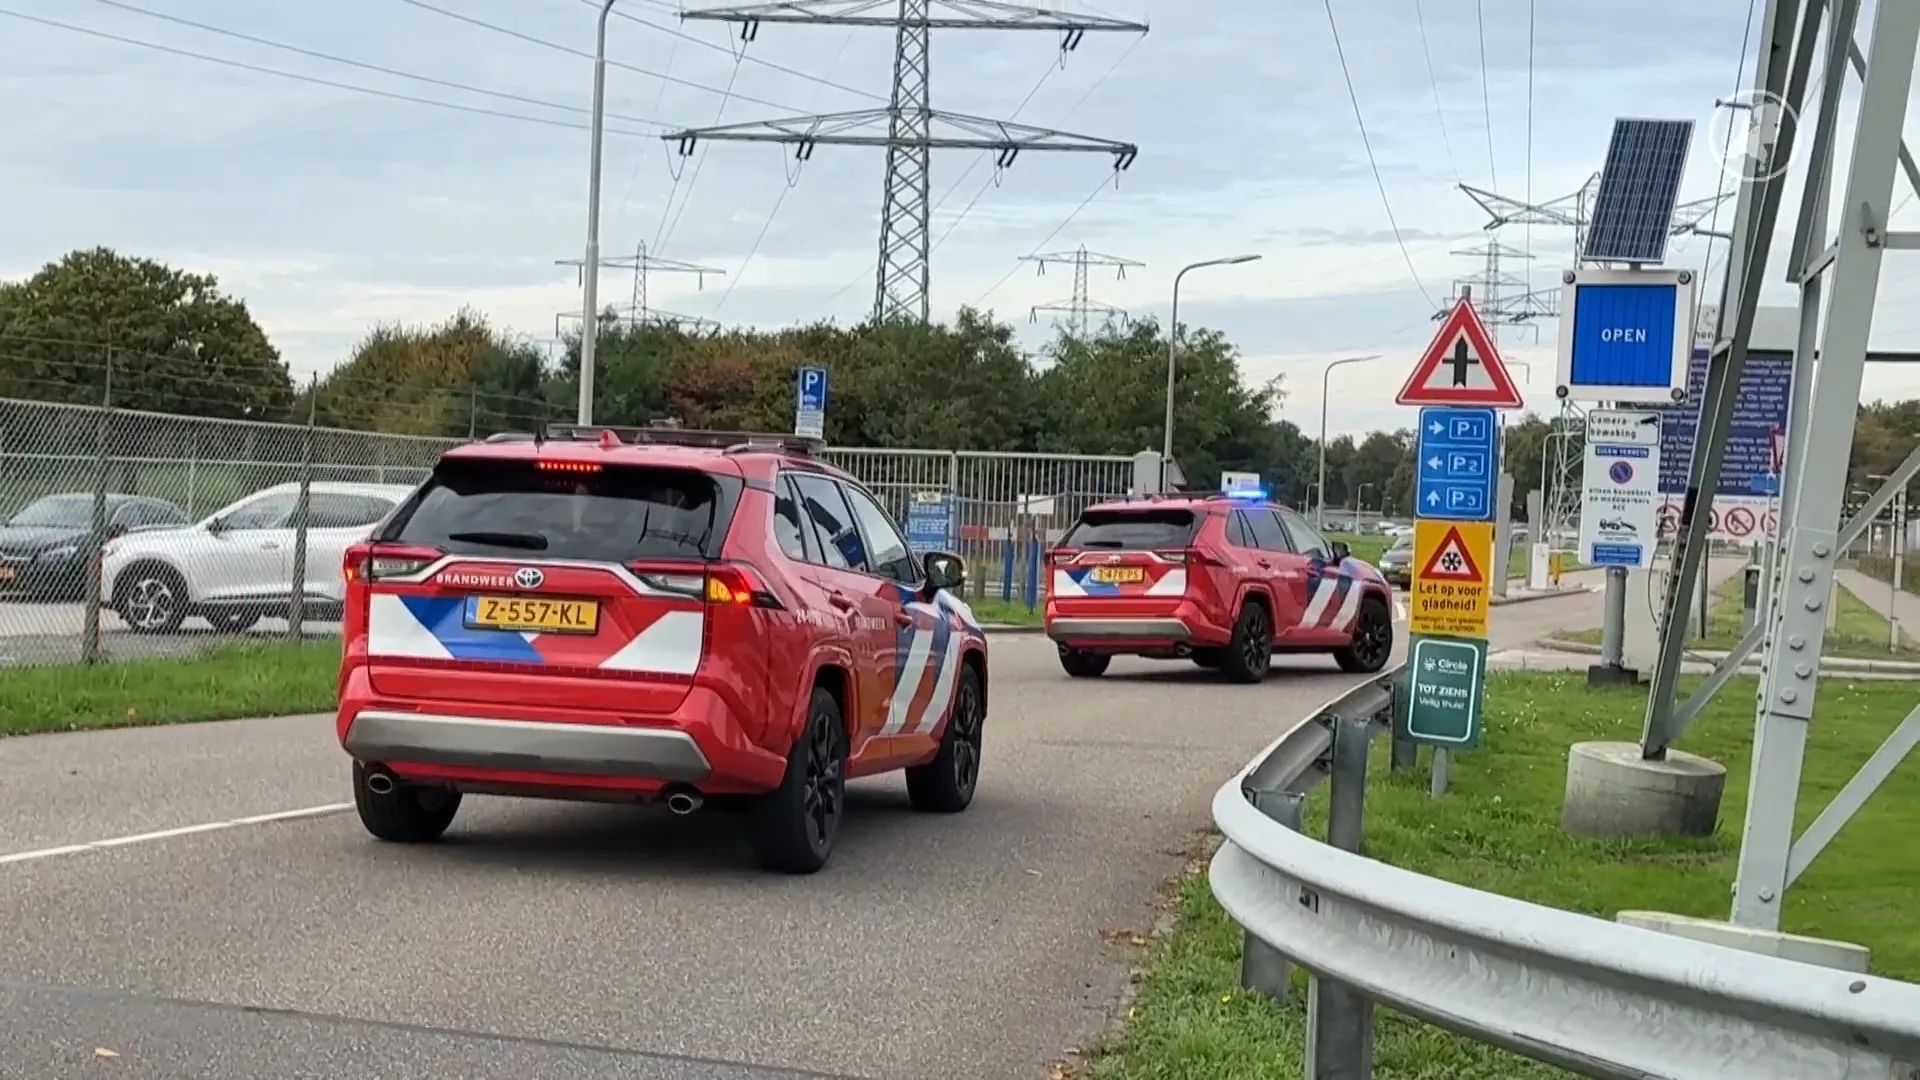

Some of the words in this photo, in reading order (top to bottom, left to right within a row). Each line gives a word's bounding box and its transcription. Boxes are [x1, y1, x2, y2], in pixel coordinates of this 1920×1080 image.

[1601, 328, 1647, 343] OPEN
[806, 370, 819, 391] P
[1457, 420, 1478, 437] P1
[1590, 428, 1637, 440] bewaking
[1453, 456, 1478, 472] P2
[1451, 490, 1477, 506] P3
[436, 573, 514, 589] BRANDWEER
[1419, 582, 1438, 595] Let
[1441, 584, 1455, 597] op
[1457, 586, 1482, 597] voor
[1421, 597, 1477, 612] gladheid!
[485, 600, 588, 626] Z-557-KL
[1438, 658, 1469, 671] Circle
[1418, 683, 1438, 696] TOT
[1439, 686, 1469, 699] ZIENS
